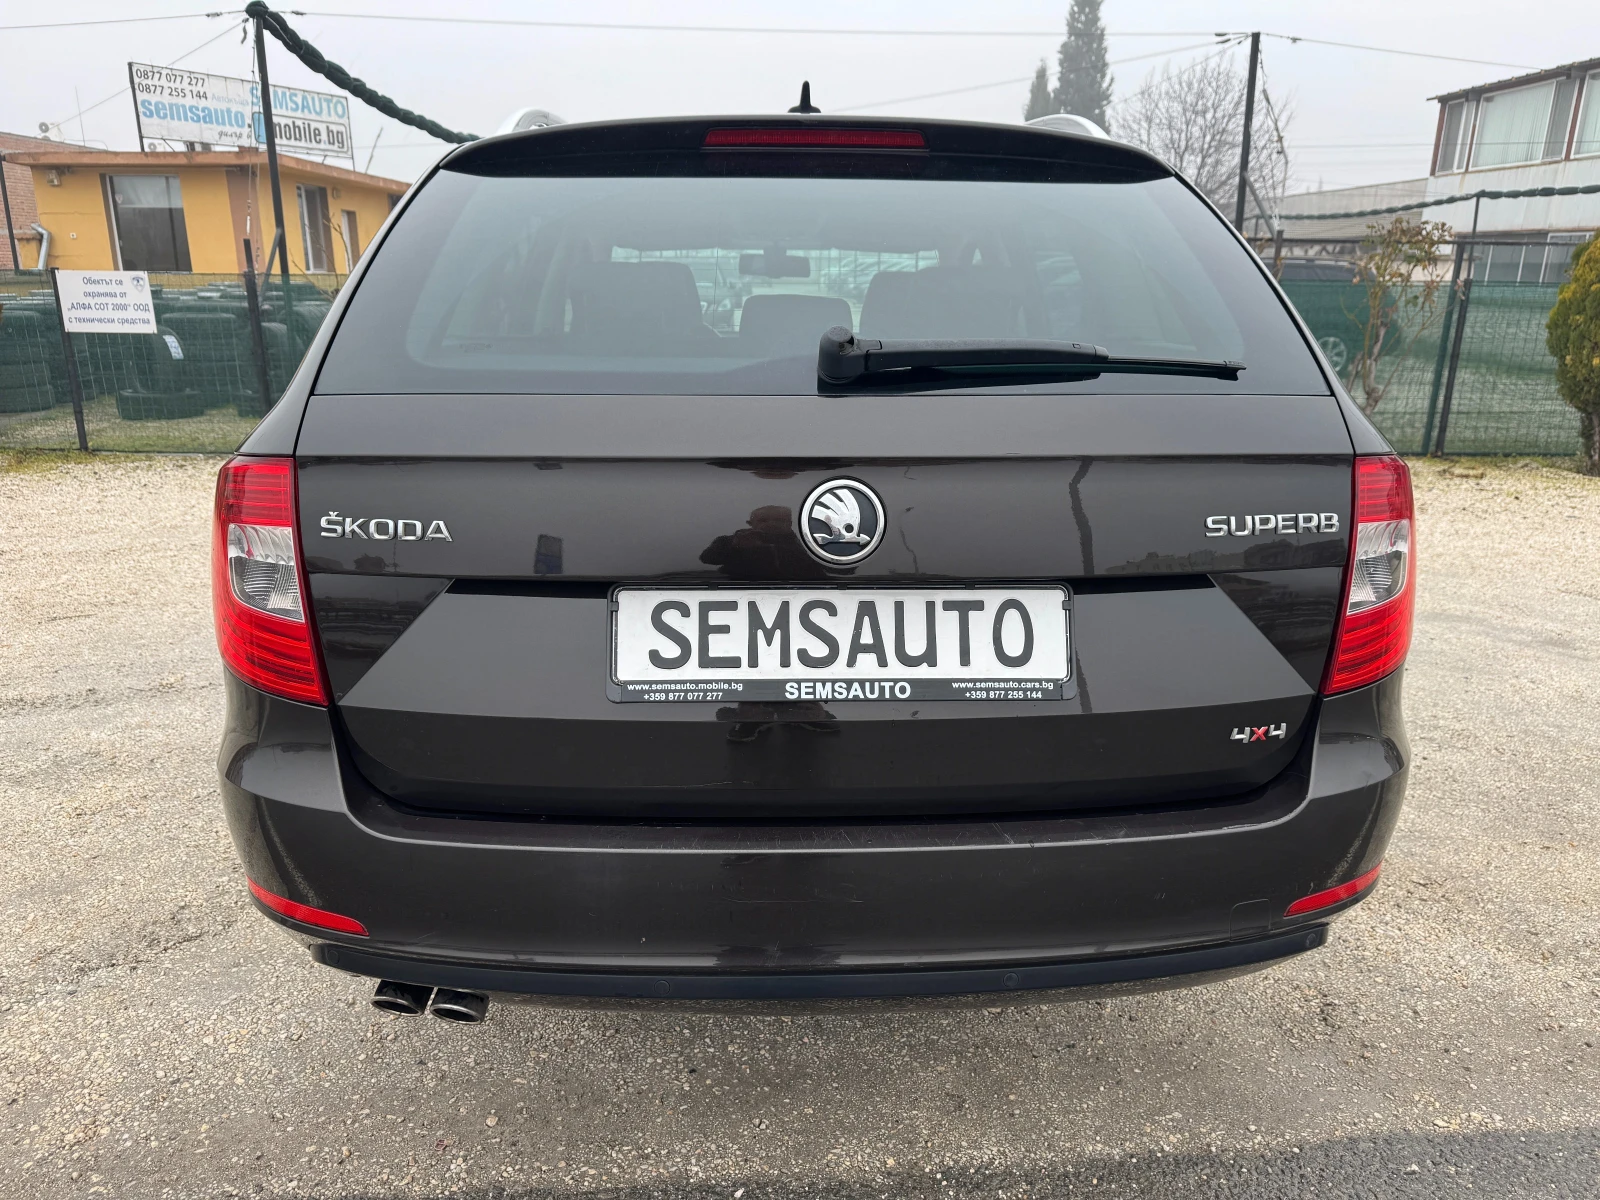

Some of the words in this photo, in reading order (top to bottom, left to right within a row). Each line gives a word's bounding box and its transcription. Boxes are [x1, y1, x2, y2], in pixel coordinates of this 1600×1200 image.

[135, 68, 163, 82] 0877
[165, 73, 184, 85] 077
[186, 75, 206, 88] 277
[137, 82, 165, 95] 0877
[167, 87, 187, 98] 255
[189, 90, 208, 101] 144
[249, 85, 347, 119] SMSAUTO
[82, 276, 113, 286] Обектът
[83, 291, 118, 300] охранява
[94, 302, 109, 311] СОТ
[133, 303, 151, 313] ООД
[74, 317, 116, 325] технически
[116, 318, 151, 326] средства
[320, 511, 453, 542] ŠKODA
[1205, 512, 1340, 538] SUPERB
[648, 599, 1035, 669] SEMSAUTO
[627, 681, 743, 691] www.semsauto.mobile.bg
[784, 681, 911, 700] SEMSAUTO
[951, 680, 1054, 690] www.semsauto.cars.bg
[643, 692, 666, 701] +359
[668, 692, 685, 701] 877
[687, 692, 704, 700] 077
[706, 692, 723, 700] 277
[964, 691, 986, 699] +359
[988, 691, 1005, 699] 877
[1007, 690, 1024, 699] 255
[1026, 690, 1043, 699] 144
[1230, 722, 1287, 743] 4x4
